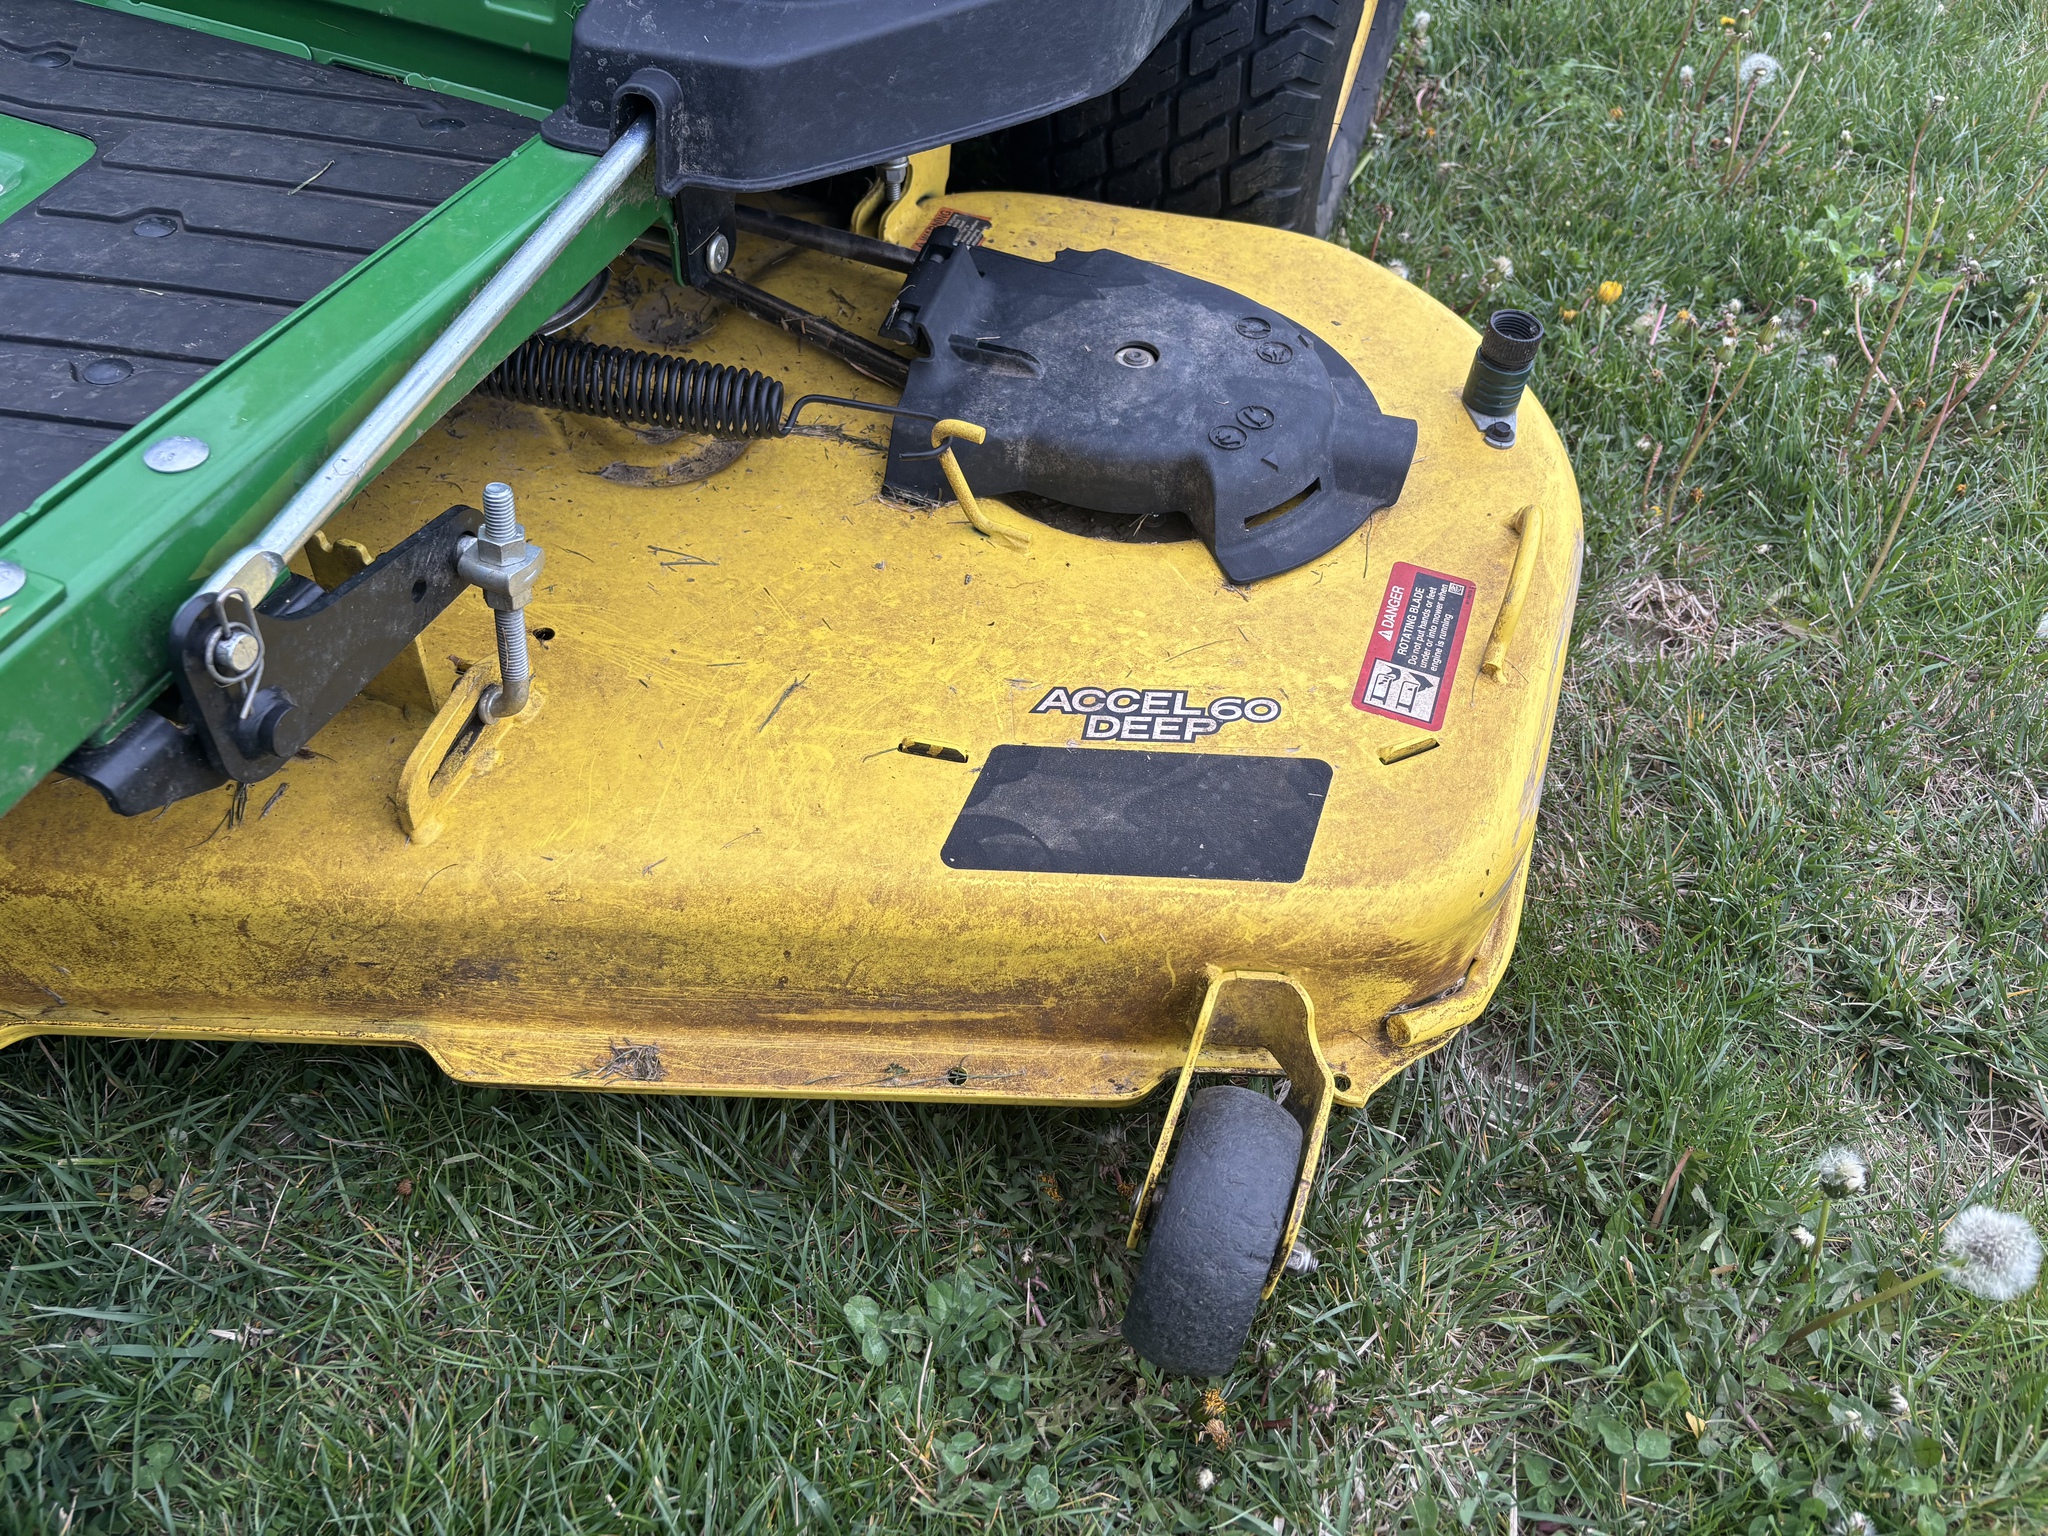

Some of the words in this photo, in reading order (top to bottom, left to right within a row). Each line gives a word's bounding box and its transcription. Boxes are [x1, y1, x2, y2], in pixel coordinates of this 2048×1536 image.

[1426, 587, 1437, 600] feet
[1438, 584, 1448, 601] when
[1381, 586, 1404, 628] DANGER
[1426, 600, 1433, 608] or
[1433, 601, 1443, 624] mower
[1397, 615, 1416, 655] ROTATING
[1409, 587, 1424, 613] BLADE
[1418, 609, 1431, 629] hands
[1417, 630, 1425, 642] put
[1427, 626, 1437, 638] into
[1413, 642, 1421, 654] not
[1426, 639, 1433, 647] or
[1431, 648, 1442, 671] engine
[1439, 614, 1453, 639] running
[1408, 655, 1418, 665] Do
[1420, 648, 1431, 668] under
[1035, 689, 1203, 716] ACCEL
[1210, 698, 1279, 721] 60
[1085, 714, 1218, 741] DEEP
